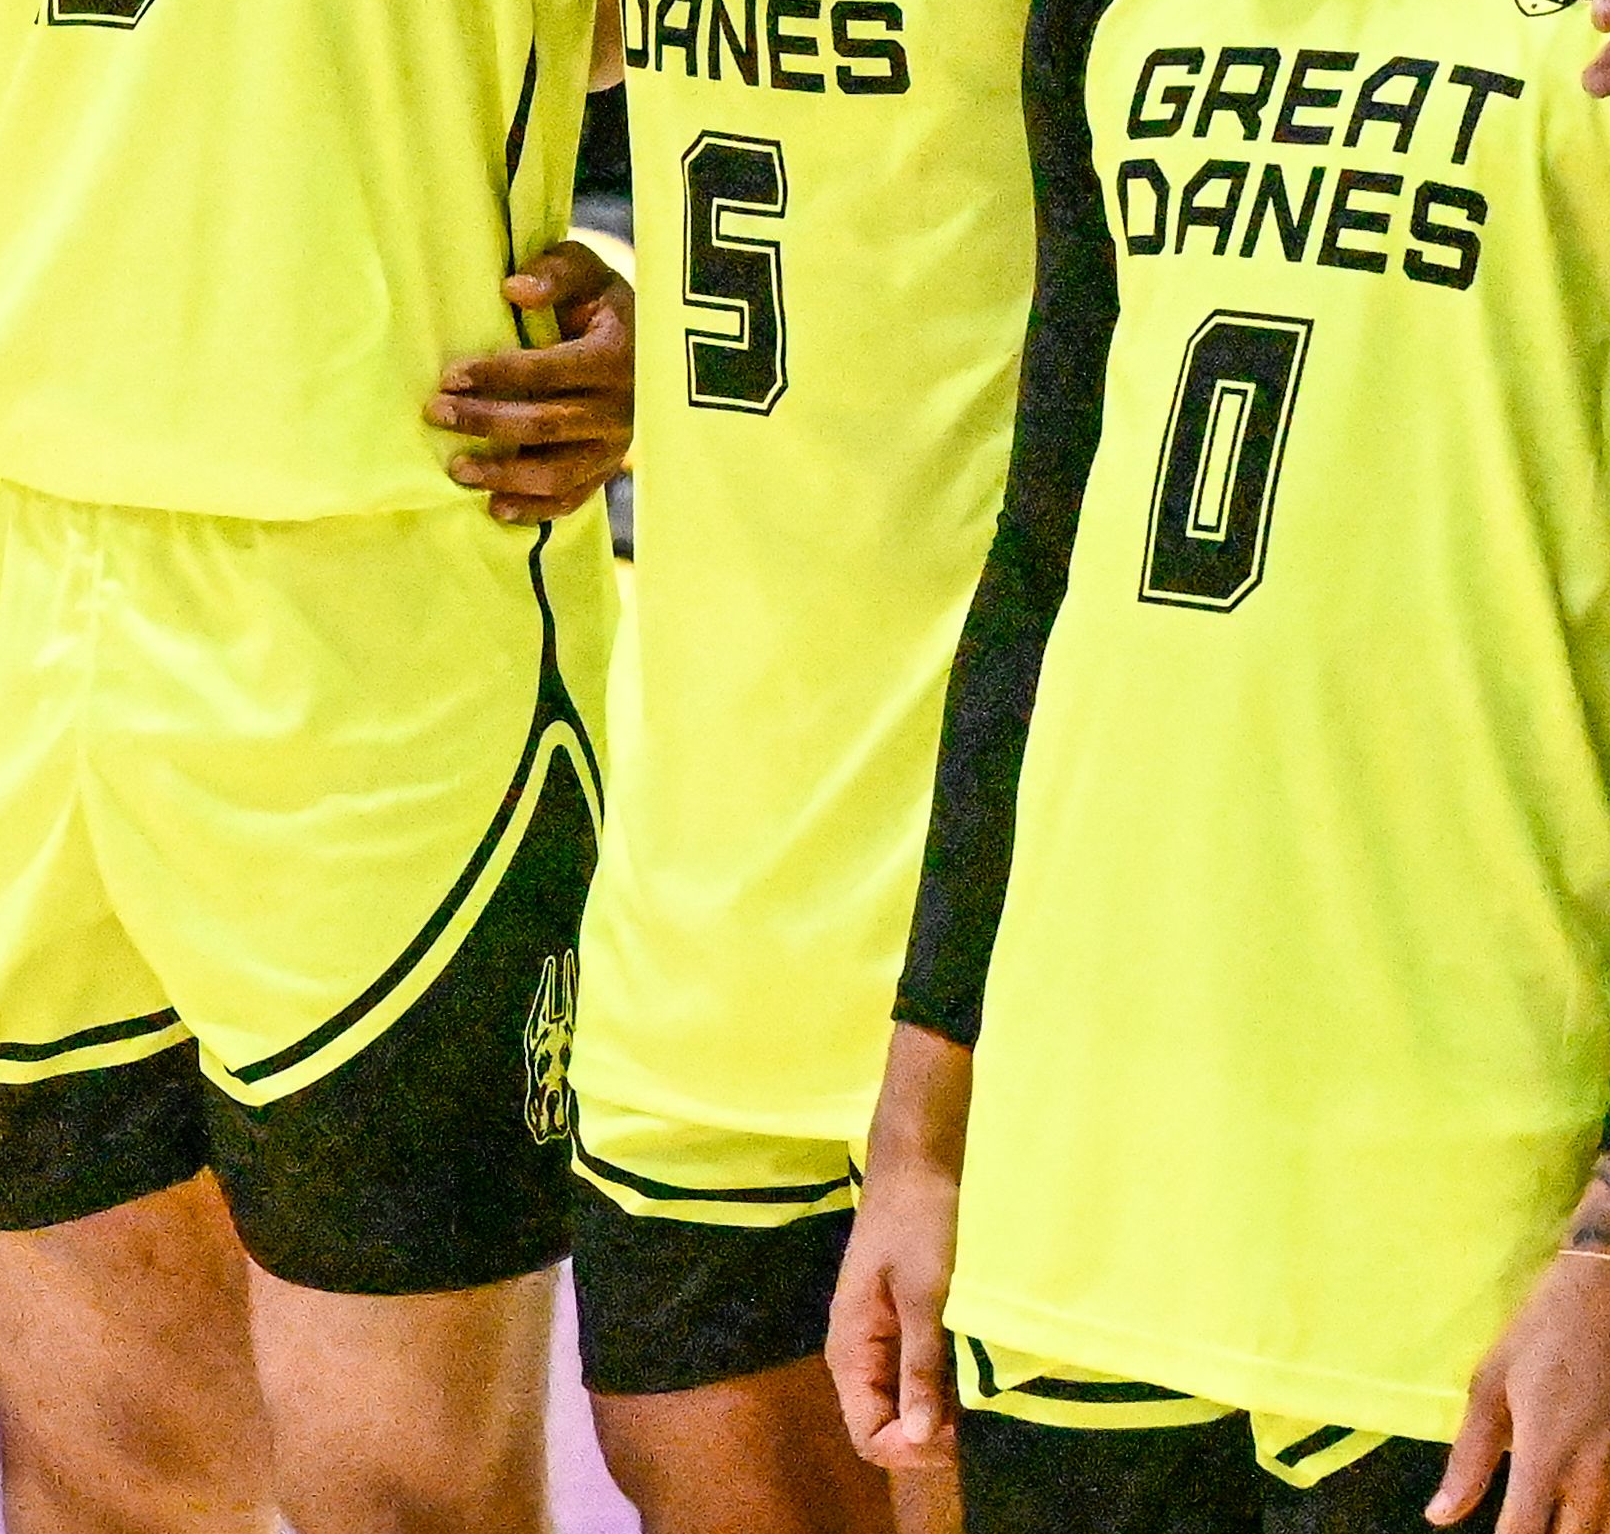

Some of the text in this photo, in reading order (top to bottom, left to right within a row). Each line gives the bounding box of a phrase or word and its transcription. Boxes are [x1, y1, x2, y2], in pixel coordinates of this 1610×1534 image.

[1127, 46, 1525, 165] GREAT
[681, 129, 789, 417] 5
[1116, 157, 1489, 292] DANES
[1138, 308, 1315, 614] 0
